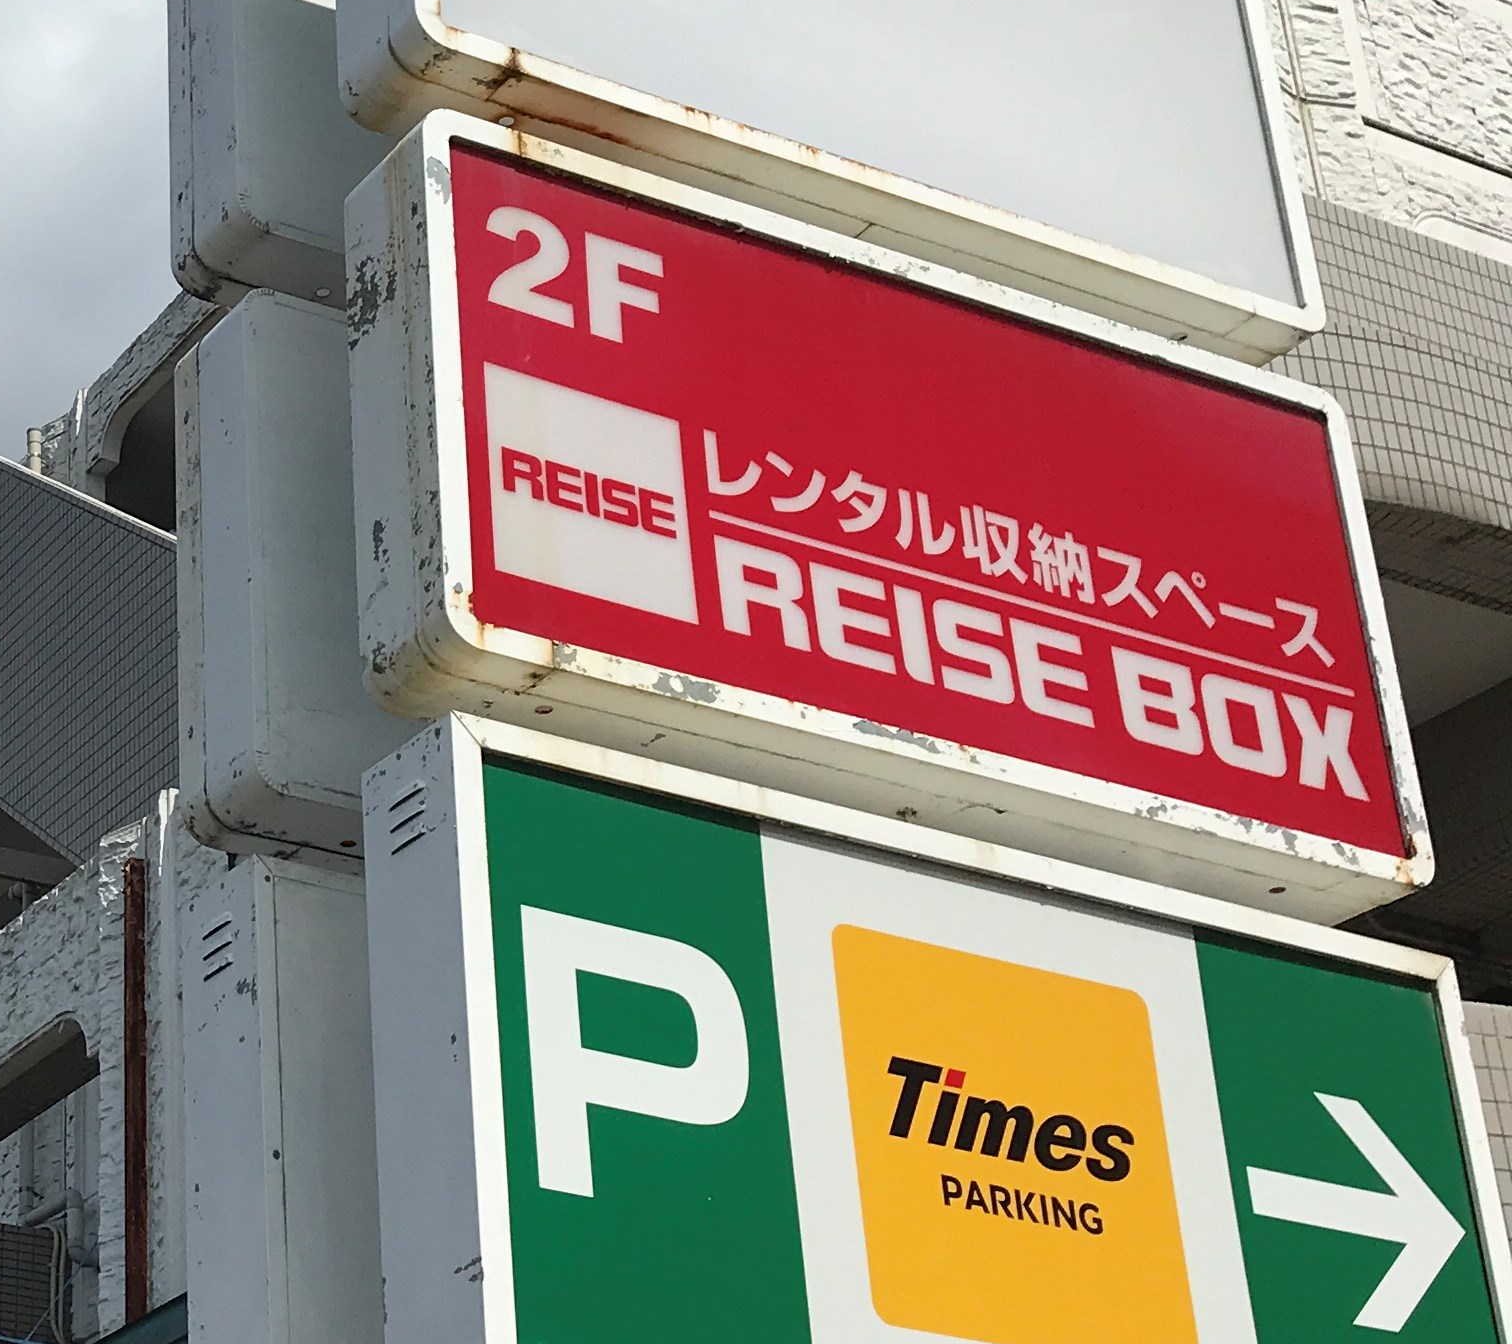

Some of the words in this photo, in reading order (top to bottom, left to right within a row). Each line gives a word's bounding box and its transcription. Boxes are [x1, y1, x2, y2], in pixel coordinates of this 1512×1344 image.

[484, 205, 665, 345] 2F
[499, 446, 678, 539] REISE
[702, 427, 1336, 670] レンタル収納スペース
[713, 532, 1095, 729] REISE
[1110, 646, 1370, 804] BOX
[520, 903, 750, 1199] P
[884, 1055, 1136, 1183] Times
[939, 1173, 1105, 1236] PARKING
